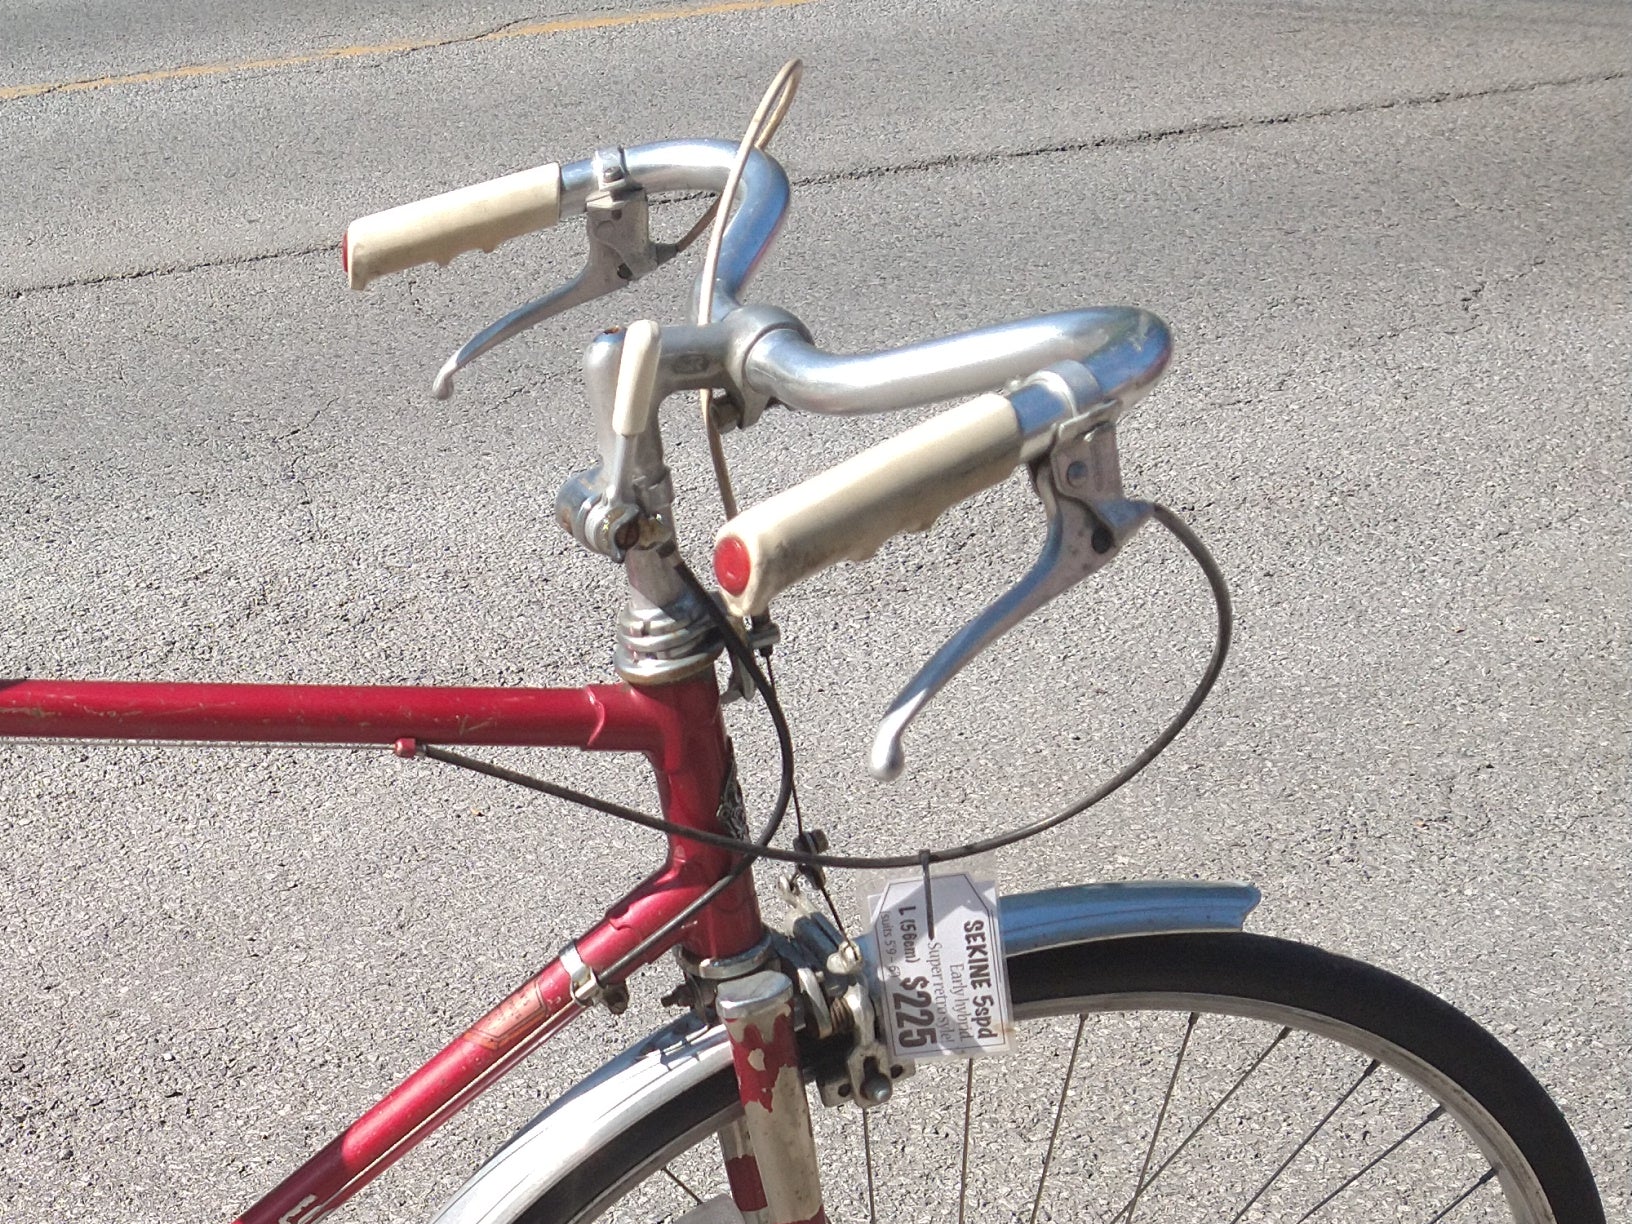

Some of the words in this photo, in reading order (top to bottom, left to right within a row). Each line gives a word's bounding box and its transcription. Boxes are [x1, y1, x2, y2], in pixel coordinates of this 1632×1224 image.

[898, 905, 917, 916] L
[899, 919, 921, 963] (56cm)
[926, 942, 943, 978] Super
[963, 919, 992, 990] SEKINE
[933, 980, 948, 1015] retro
[950, 963, 967, 995] Early
[892, 975, 938, 1048] $225
[971, 994, 998, 1039] 5spd
